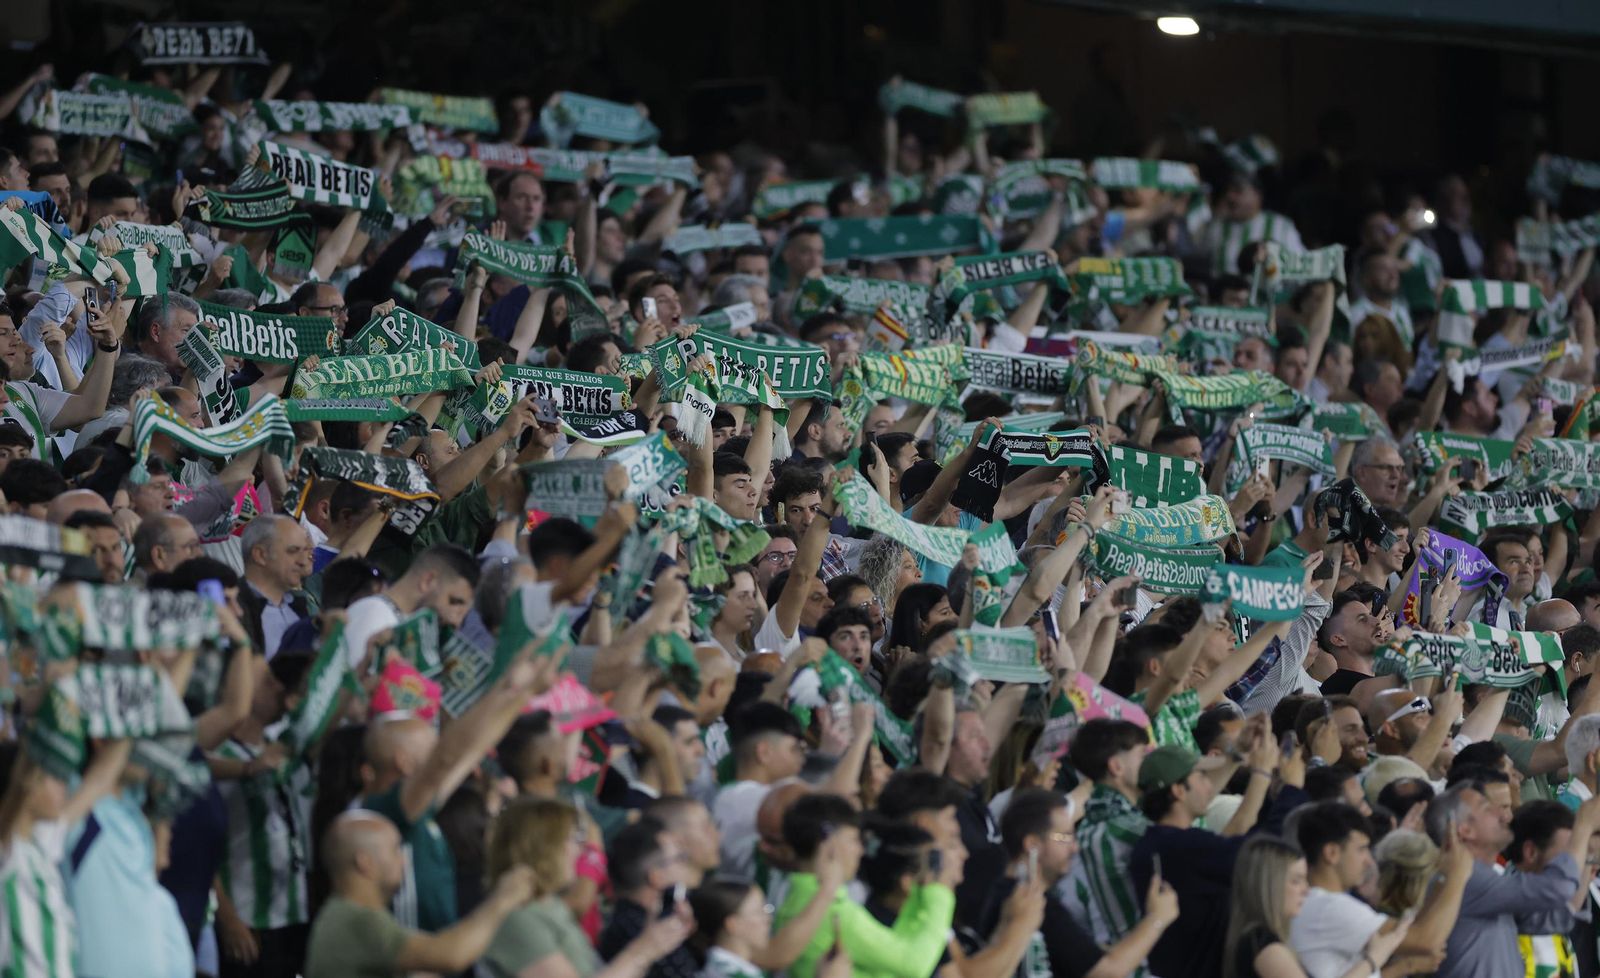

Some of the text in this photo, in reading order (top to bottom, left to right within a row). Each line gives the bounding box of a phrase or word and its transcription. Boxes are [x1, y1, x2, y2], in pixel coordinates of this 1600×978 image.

[207, 25, 256, 56] BETI
[271, 152, 372, 198] REAL BETIS
[437, 328, 477, 366] BETI
[517, 367, 604, 385] DICEN QUE ESTAMOS
[560, 382, 614, 417] BETIS
[1102, 543, 1208, 586] RealBetisBalom
